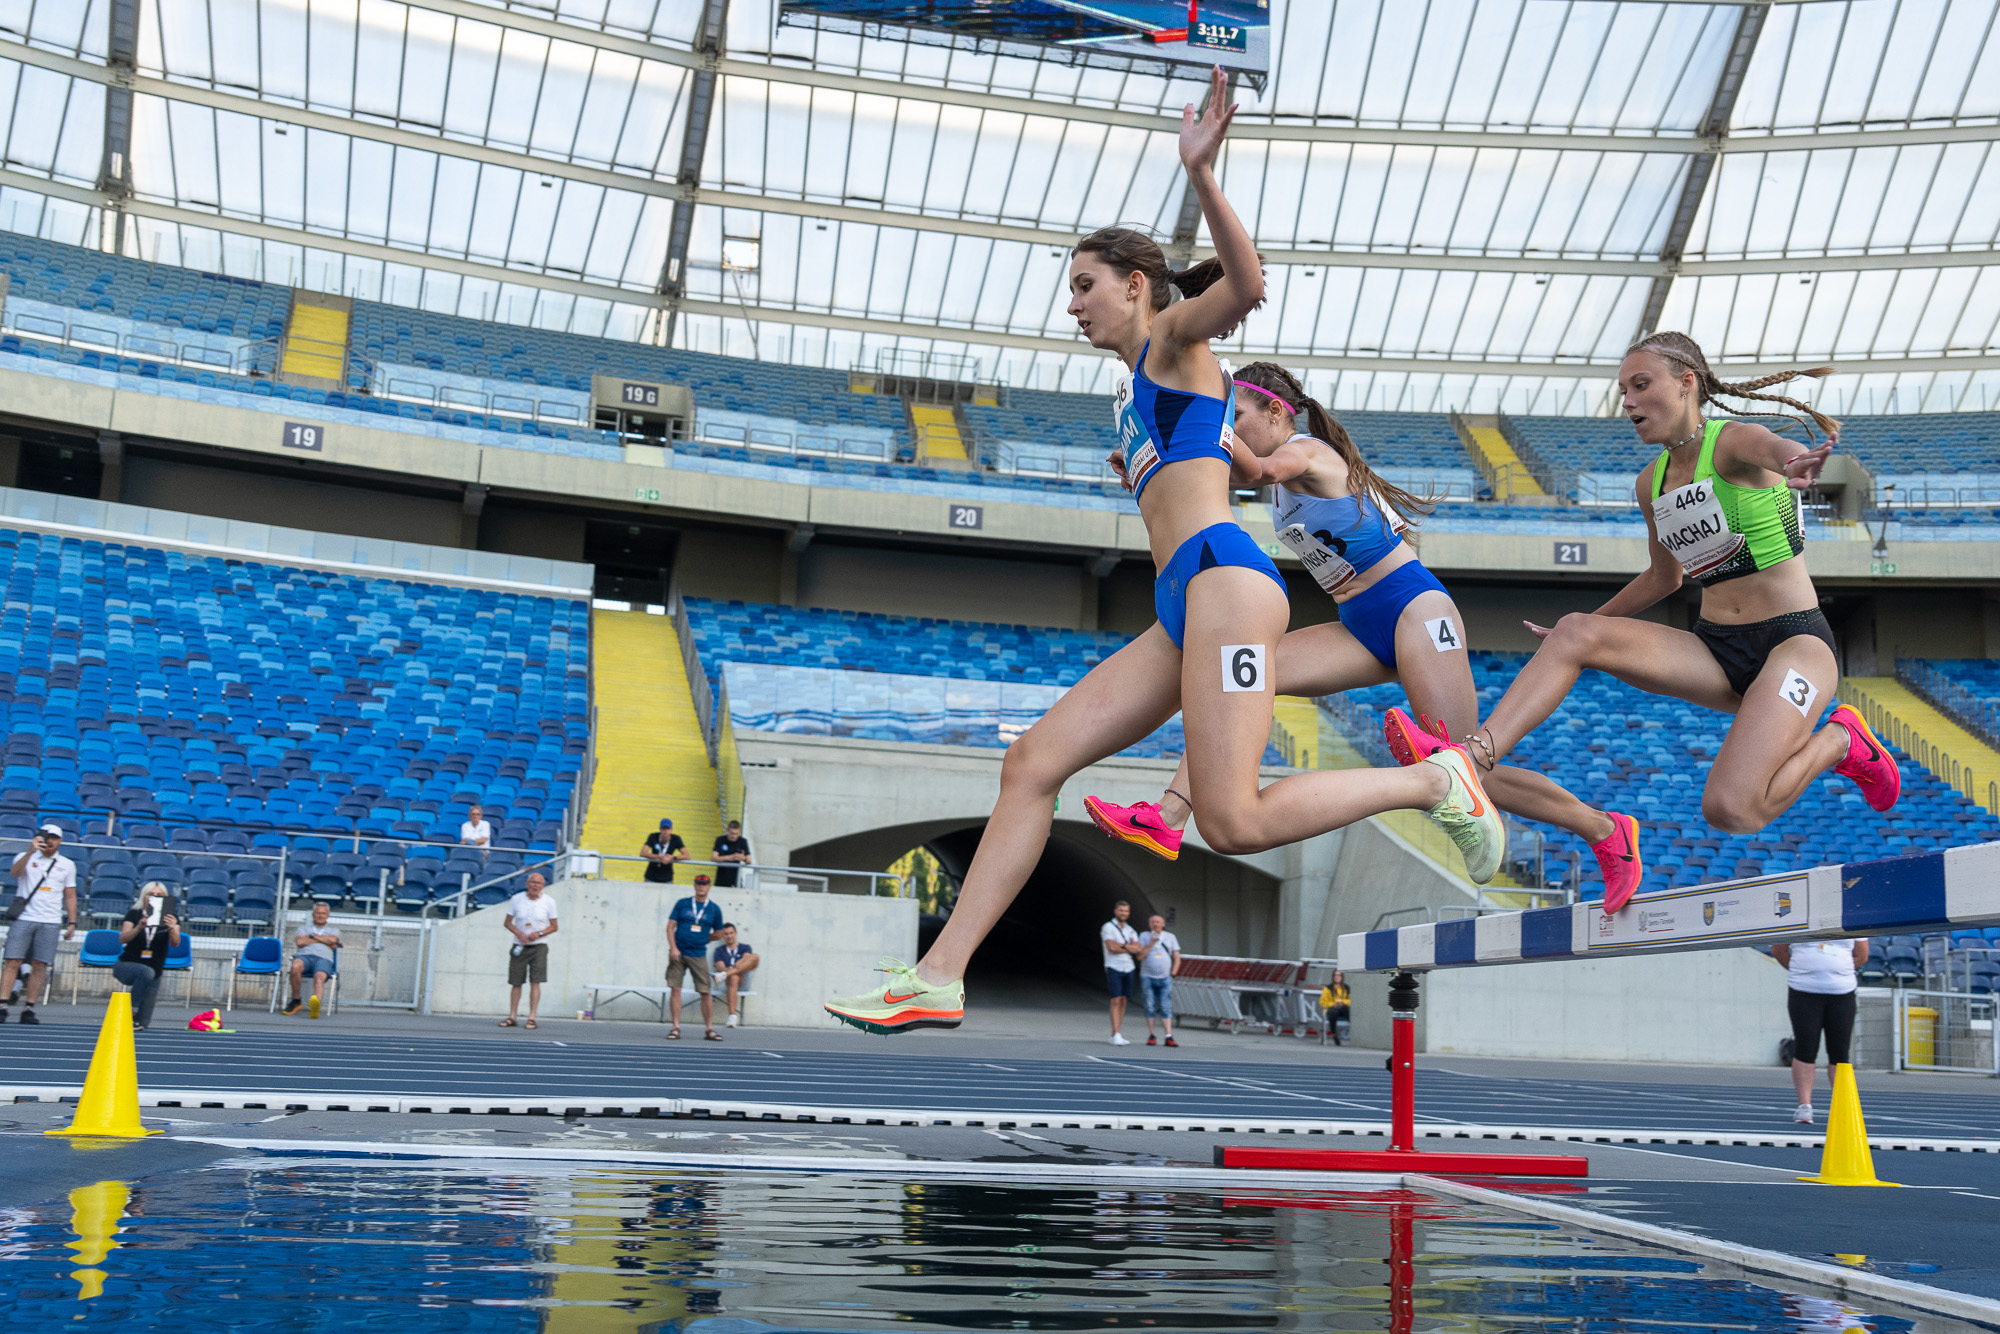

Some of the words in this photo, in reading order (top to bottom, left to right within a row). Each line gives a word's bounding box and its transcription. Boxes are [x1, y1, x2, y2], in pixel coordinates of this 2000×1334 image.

[1198, 22, 1239, 40] 3:11.7
[625, 386, 644, 402] 19
[646, 391, 657, 404] G
[291, 426, 316, 447] 19
[1676, 485, 1706, 510] 446
[955, 507, 977, 527] 20
[1661, 513, 1721, 552] MACHAJ
[1560, 544, 1580, 563] 21
[1438, 619, 1456, 647] 4
[1232, 648, 1258, 688] 6
[1788, 677, 1810, 707] 3
